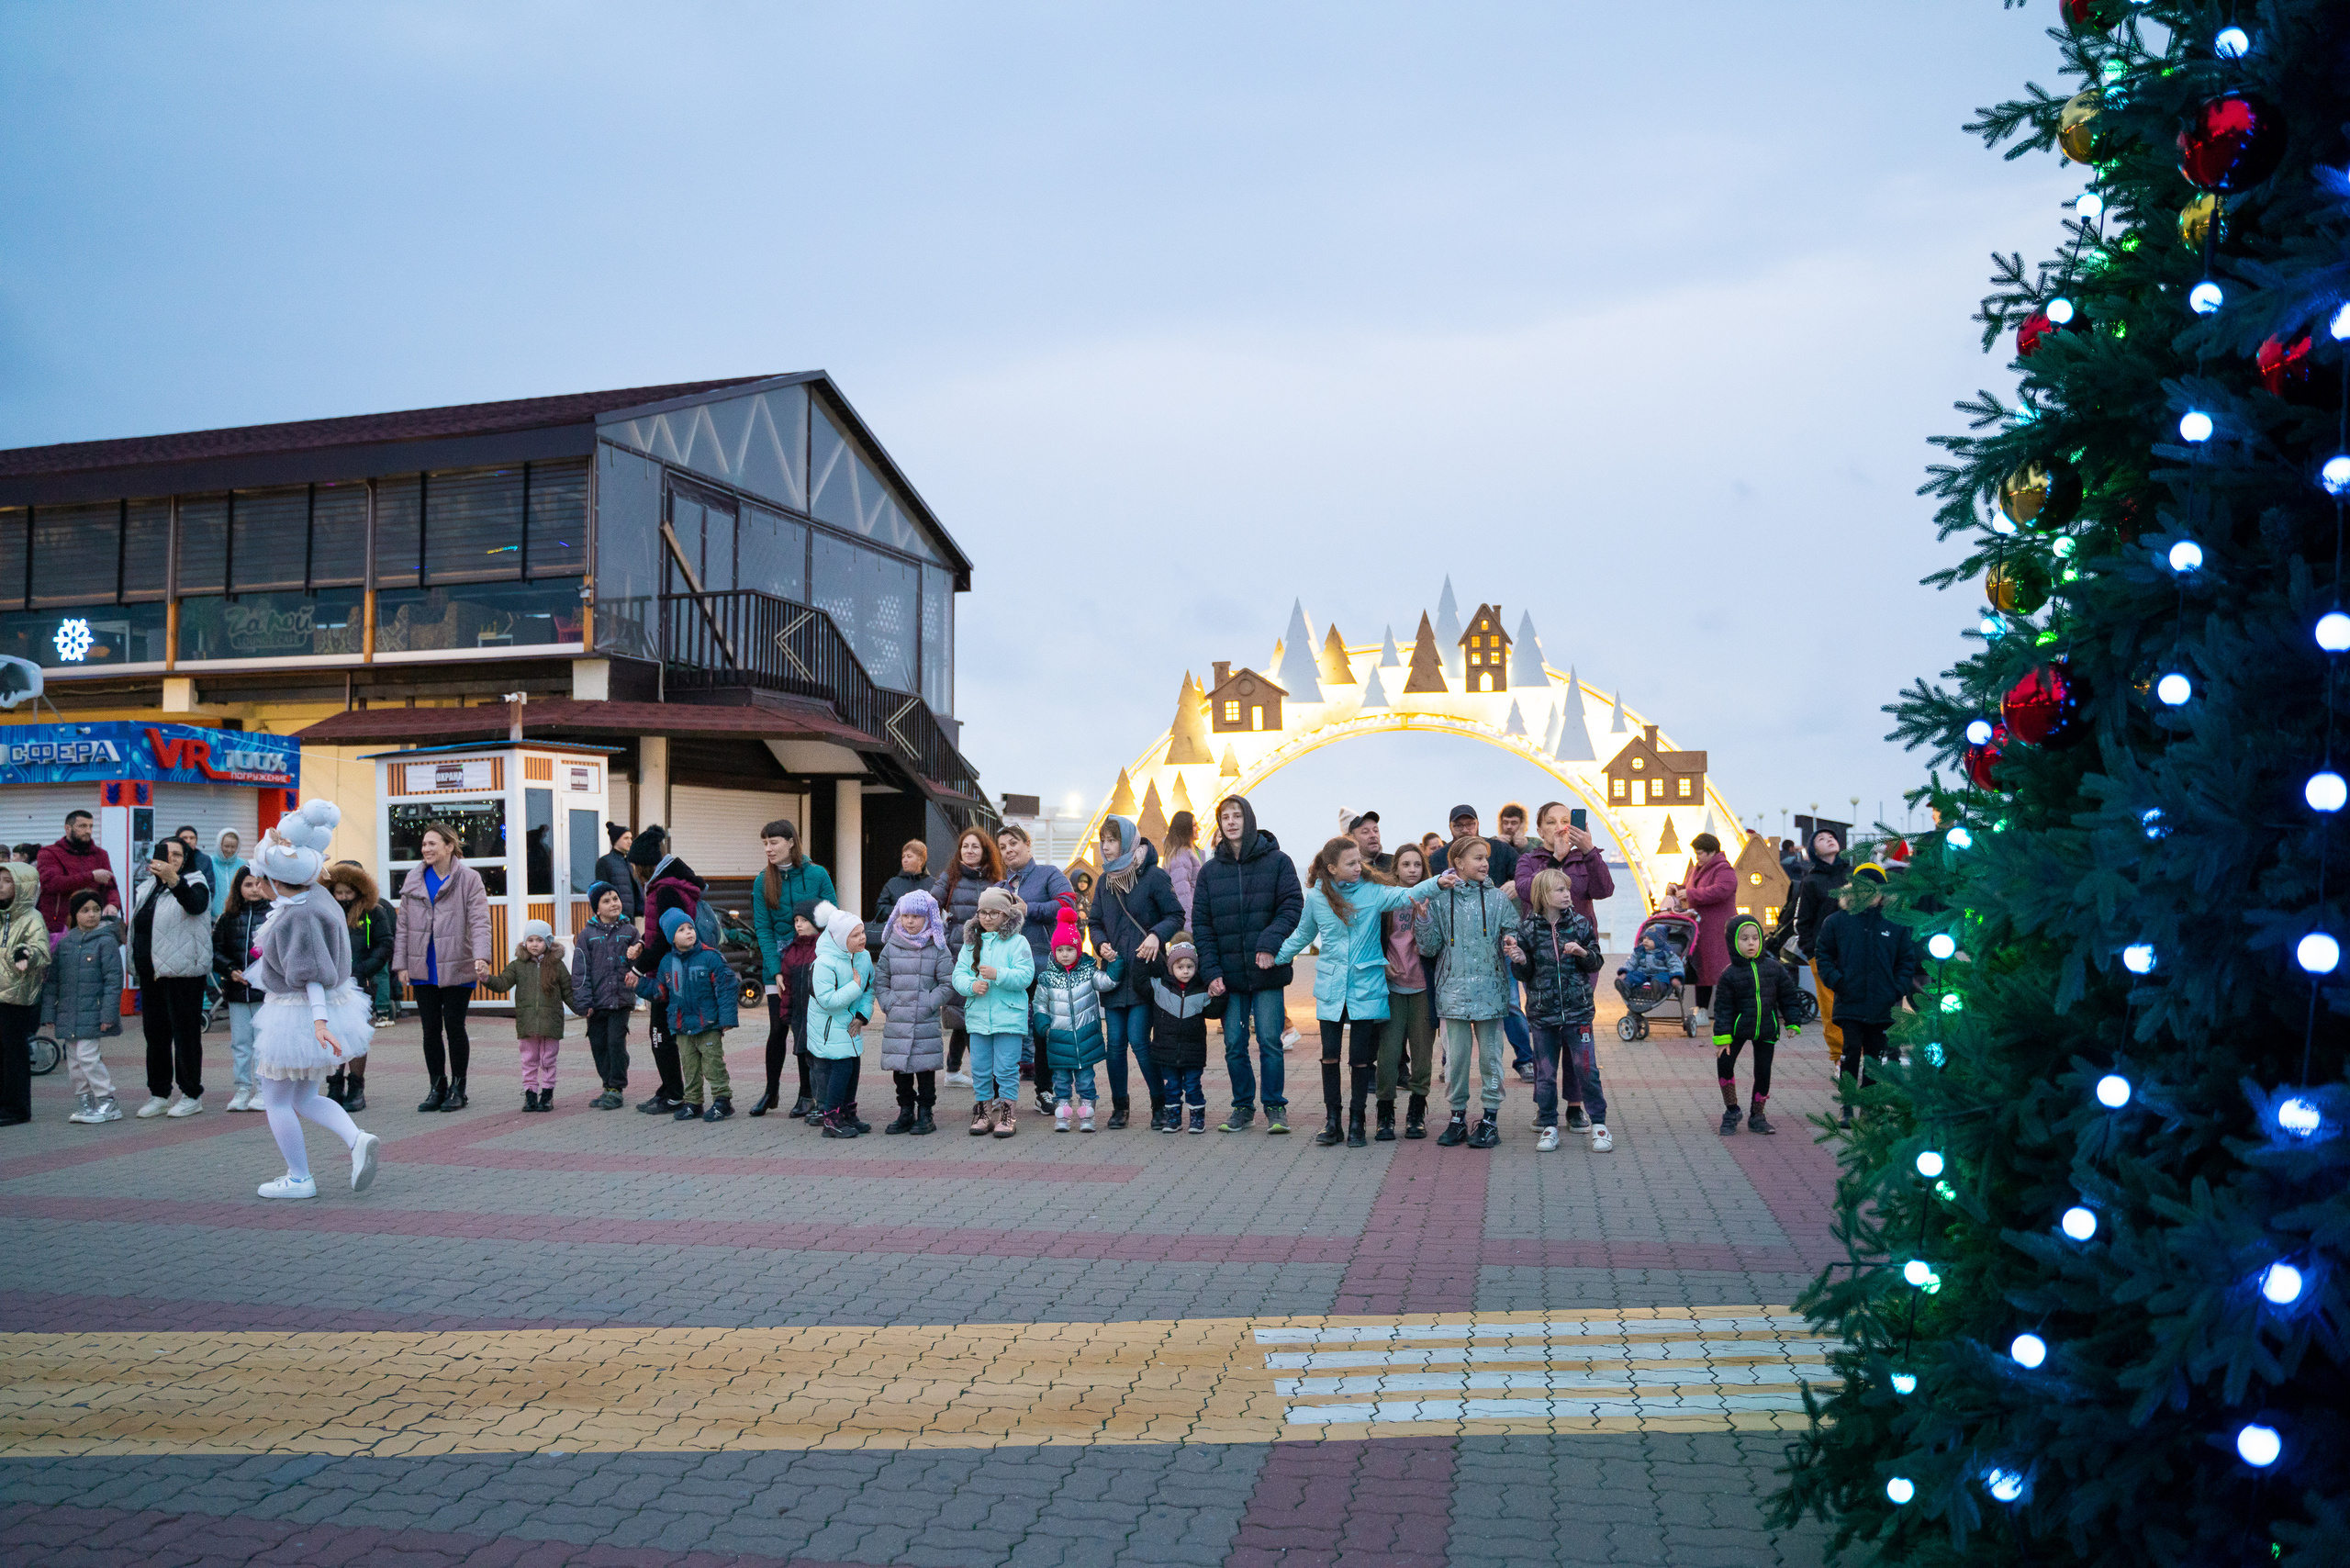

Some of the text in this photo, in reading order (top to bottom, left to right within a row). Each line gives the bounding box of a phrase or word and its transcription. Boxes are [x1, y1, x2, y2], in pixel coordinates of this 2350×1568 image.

[9, 741, 120, 766] СФЕРА
[144, 728, 221, 778] VR
[224, 749, 287, 772] 100%
[231, 772, 287, 783] ПОГРУЖЕНИЕ
[436, 771, 463, 782] ОХРАНА
